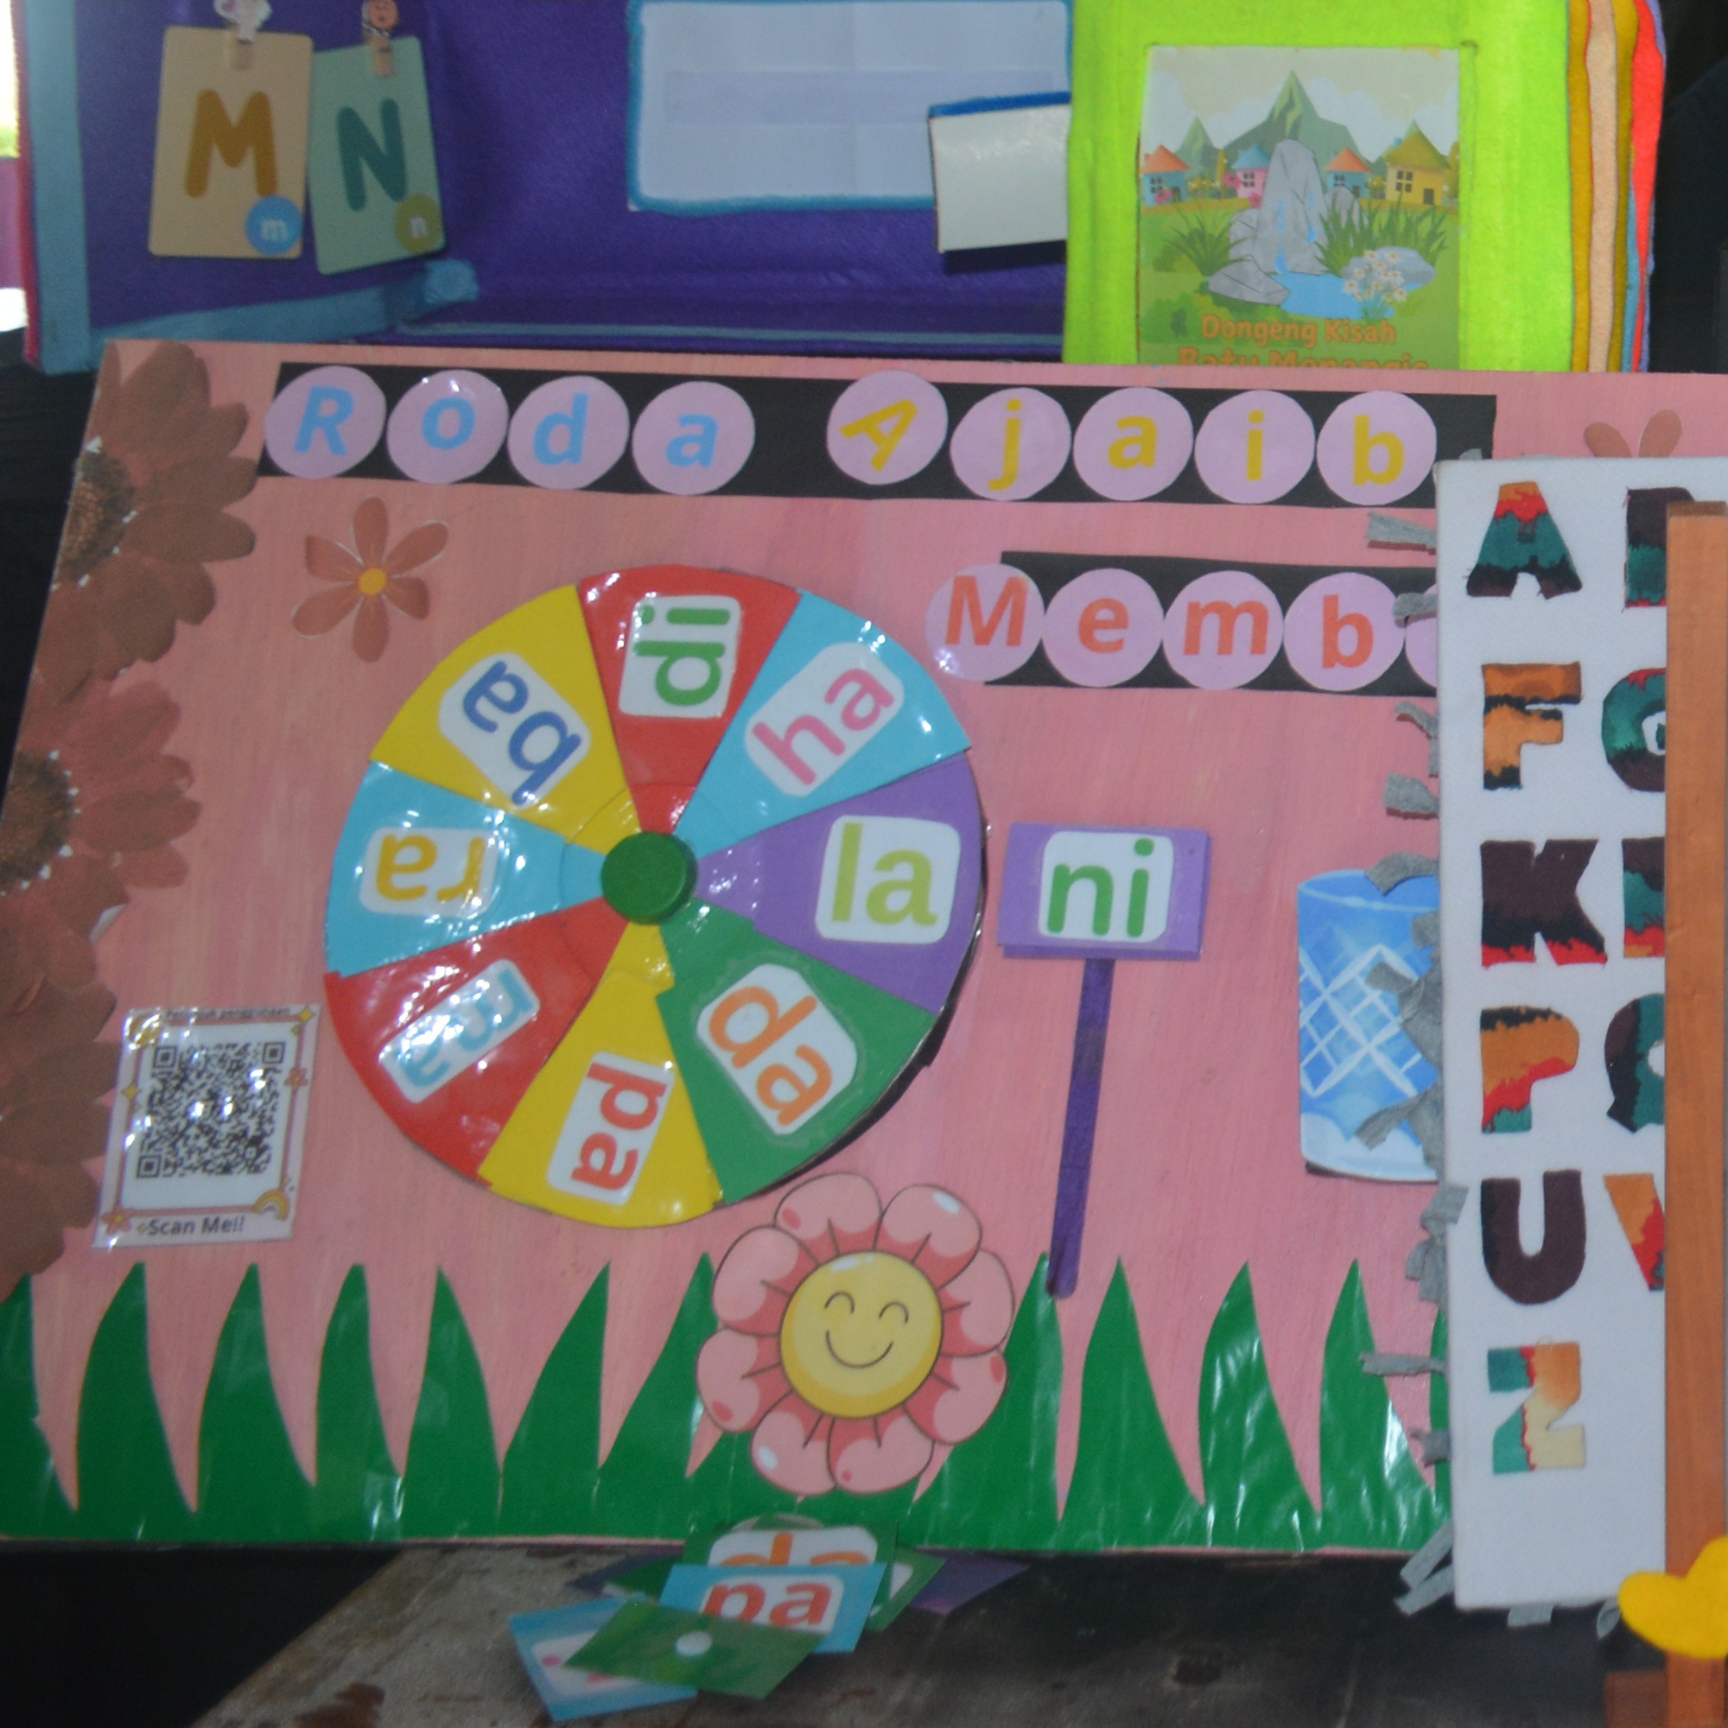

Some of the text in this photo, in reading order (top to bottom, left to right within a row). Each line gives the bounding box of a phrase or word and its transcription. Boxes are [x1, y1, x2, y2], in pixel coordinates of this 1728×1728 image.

[185, 89, 407, 211] M N
[1201, 314, 1396, 349] Dongeng Kisah
[293, 385, 1406, 493] Roda Ajaib
[1465, 480, 1582, 600] A
[635, 593, 730, 706] di
[944, 576, 1376, 670] Memb
[751, 665, 897, 787] ha
[1481, 662, 1582, 790] F
[830, 823, 938, 928] la
[1045, 837, 1157, 939] ni
[1481, 838, 1608, 968] K
[707, 984, 834, 1127] da
[1480, 1006, 1579, 1133] P
[570, 1063, 670, 1194] pa
[148, 1217, 195, 1235] Scan
[1480, 1169, 1587, 1305] U
